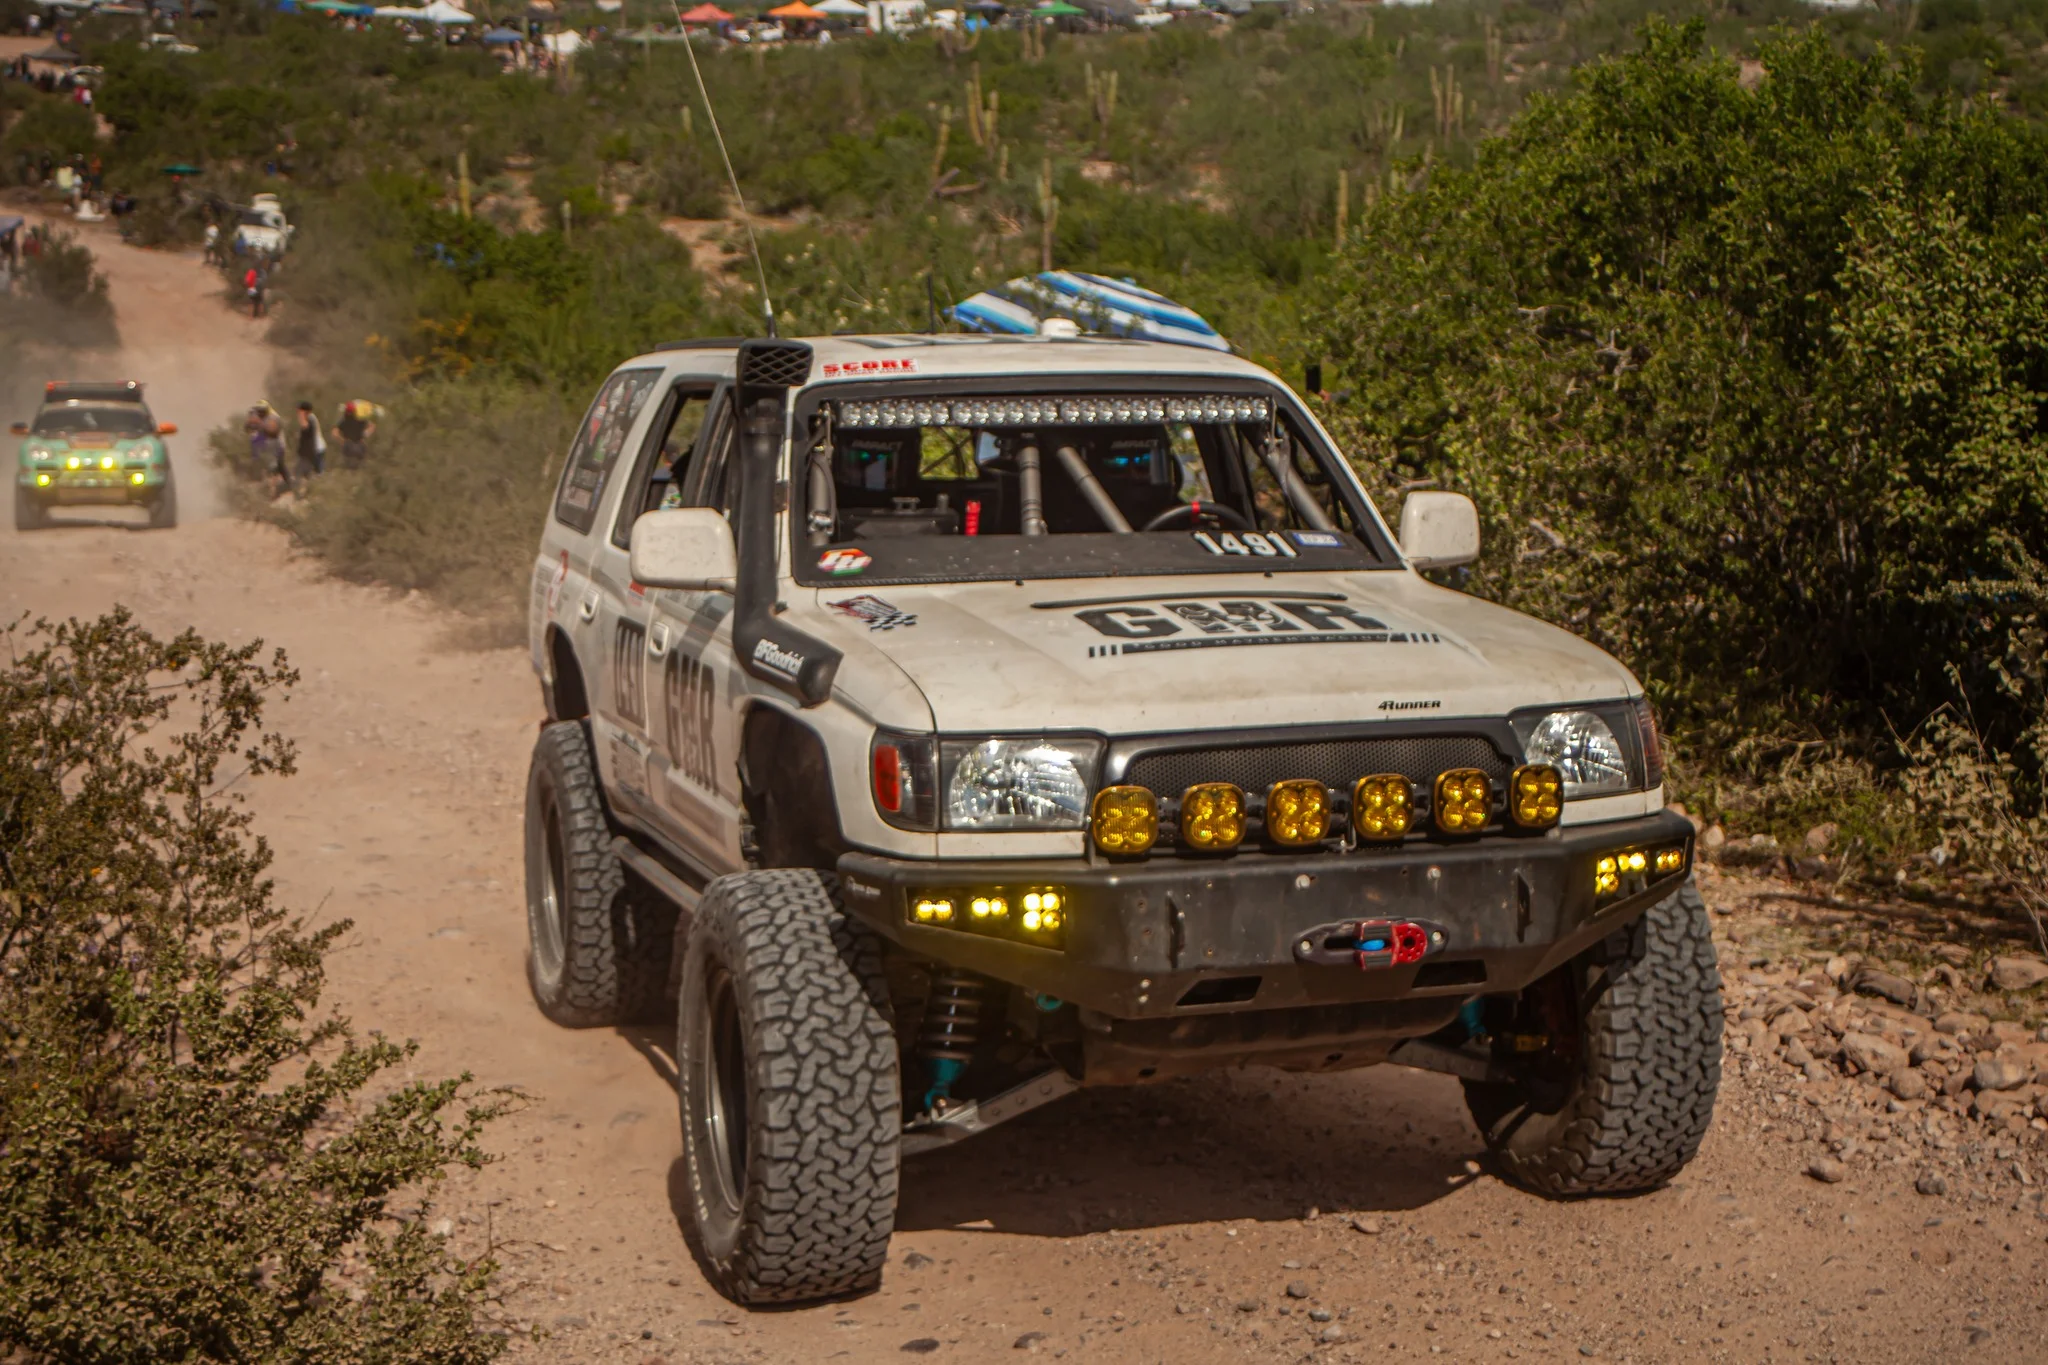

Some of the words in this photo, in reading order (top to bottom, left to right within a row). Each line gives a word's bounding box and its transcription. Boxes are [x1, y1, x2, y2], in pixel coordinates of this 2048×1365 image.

[823, 359, 914, 372] SCORE
[1110, 438, 1160, 449] IMPACT
[1194, 531, 1297, 557] 1491
[1074, 601, 1390, 638] GMR
[753, 639, 805, 676] BFGoodrich
